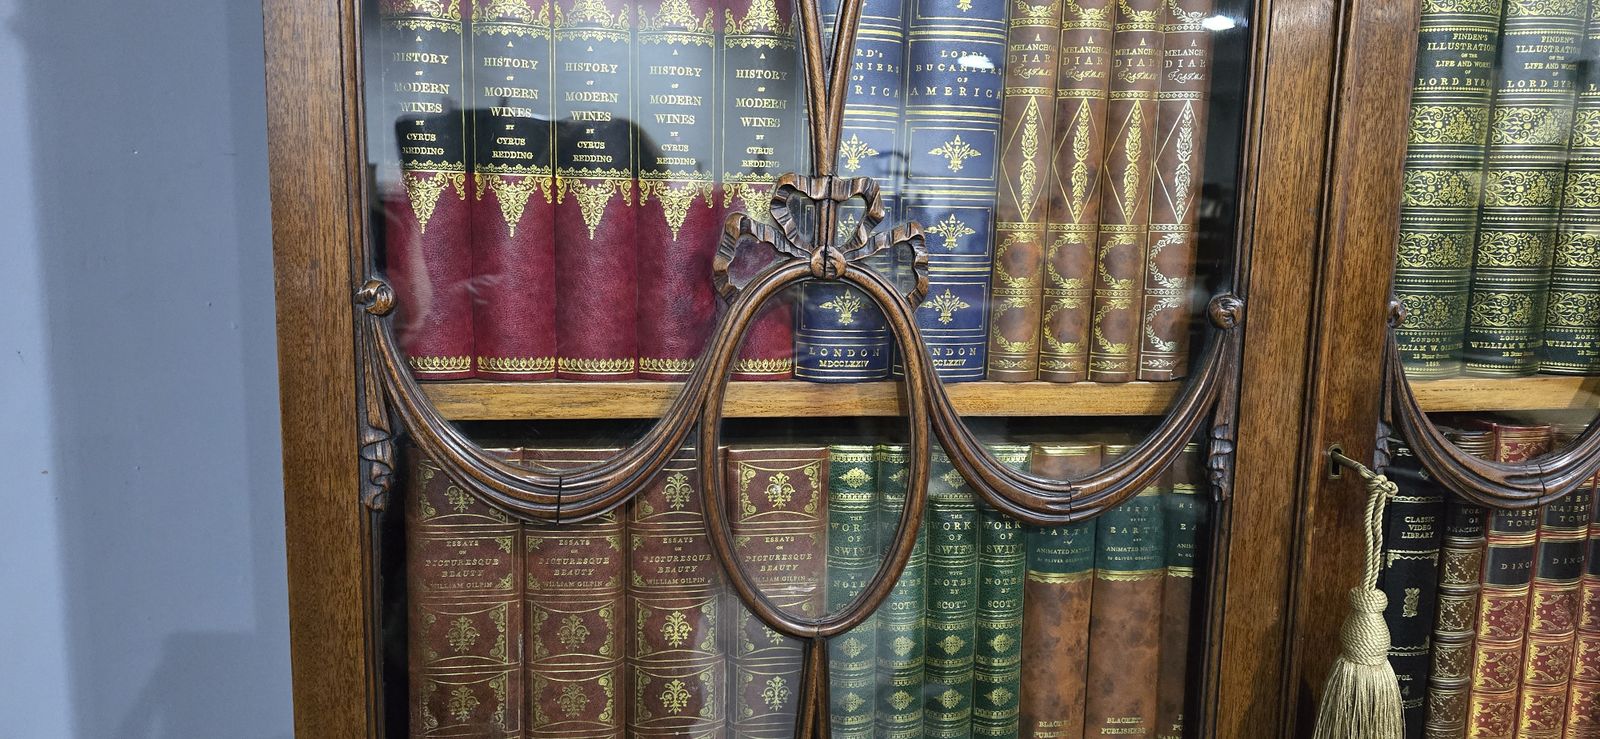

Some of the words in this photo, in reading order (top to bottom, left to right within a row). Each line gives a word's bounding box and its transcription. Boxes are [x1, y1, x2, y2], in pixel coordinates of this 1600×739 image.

[1035, 33, 1041, 41] A
[1087, 35, 1094, 44] A
[1140, 37, 1147, 46] A
[1453, 33, 1488, 41] FINDEN'S
[1190, 39, 1197, 47] A
[856, 48, 883, 58] RD's
[1164, 49, 1207, 57] MELANCH
[392, 52, 449, 65] HISTORY
[483, 56, 539, 70] HISTORY
[565, 62, 618, 74] HISTORY
[855, 62, 899, 74] NIERS
[1435, 60, 1455, 68] LIFE
[1524, 62, 1544, 70] LIFE
[649, 66, 703, 78] HISTORY
[736, 69, 787, 81] HISTORY
[1418, 77, 1459, 86] LORD
[1507, 79, 1548, 88] LORD
[393, 82, 450, 95] MODERN
[484, 86, 539, 100] MODERN
[855, 84, 899, 99] RICA
[910, 86, 1001, 100] AMERICA
[565, 92, 619, 104] MODERN
[649, 95, 702, 106] MODERN
[400, 102, 443, 114] WINES
[735, 98, 787, 110] MODERN
[489, 106, 532, 118] WINES
[571, 111, 612, 122] WINES
[655, 113, 695, 125] WINES
[740, 117, 781, 128] WINES
[406, 133, 436, 142] CYRUS
[496, 137, 526, 146] CYRUS
[577, 141, 606, 150] CYRUS
[661, 144, 689, 152] CYRUS
[402, 146, 445, 156] REDDING
[491, 150, 534, 160] REDDING
[746, 147, 774, 155] CYRUS
[572, 154, 613, 163] REDDING
[656, 157, 696, 166] REDDING
[741, 159, 780, 168] REDDING
[1397, 344, 1427, 352] LLIAM
[1470, 341, 1516, 349] WILLIAM
[1546, 340, 1591, 348] WILLIAM
[808, 346, 880, 358] LONDON
[932, 347, 976, 356] NDON
[819, 360, 869, 368] MDCCLXXIV
[932, 359, 966, 367] CCLXXIV
[848, 535, 861, 543] OF
[1401, 531, 1434, 539] LIBRARY
[935, 545, 974, 555] SWIFT
[986, 544, 1023, 554] SWIFT
[538, 556, 610, 566] PICTURESQUE
[643, 554, 712, 563] PICTURESQUE
[745, 553, 813, 563] PICTURESQUE
[425, 558, 500, 568] PICTURESQUE
[553, 568, 595, 576] BEAUTY
[657, 565, 698, 574] BEAUTY
[760, 564, 799, 572] BEAUTY
[441, 569, 485, 578] BEAUTY
[577, 580, 603, 588] GILPIN
[645, 577, 679, 585] WILLIAM
[757, 576, 780, 584] ILLIAM
[934, 578, 972, 587] NOTES
[466, 581, 493, 589] GILPIN
[834, 581, 866, 589] NOTE
[891, 601, 918, 610] COTT
[937, 600, 968, 610] SCOTT
[987, 599, 1017, 608] SCOTT
